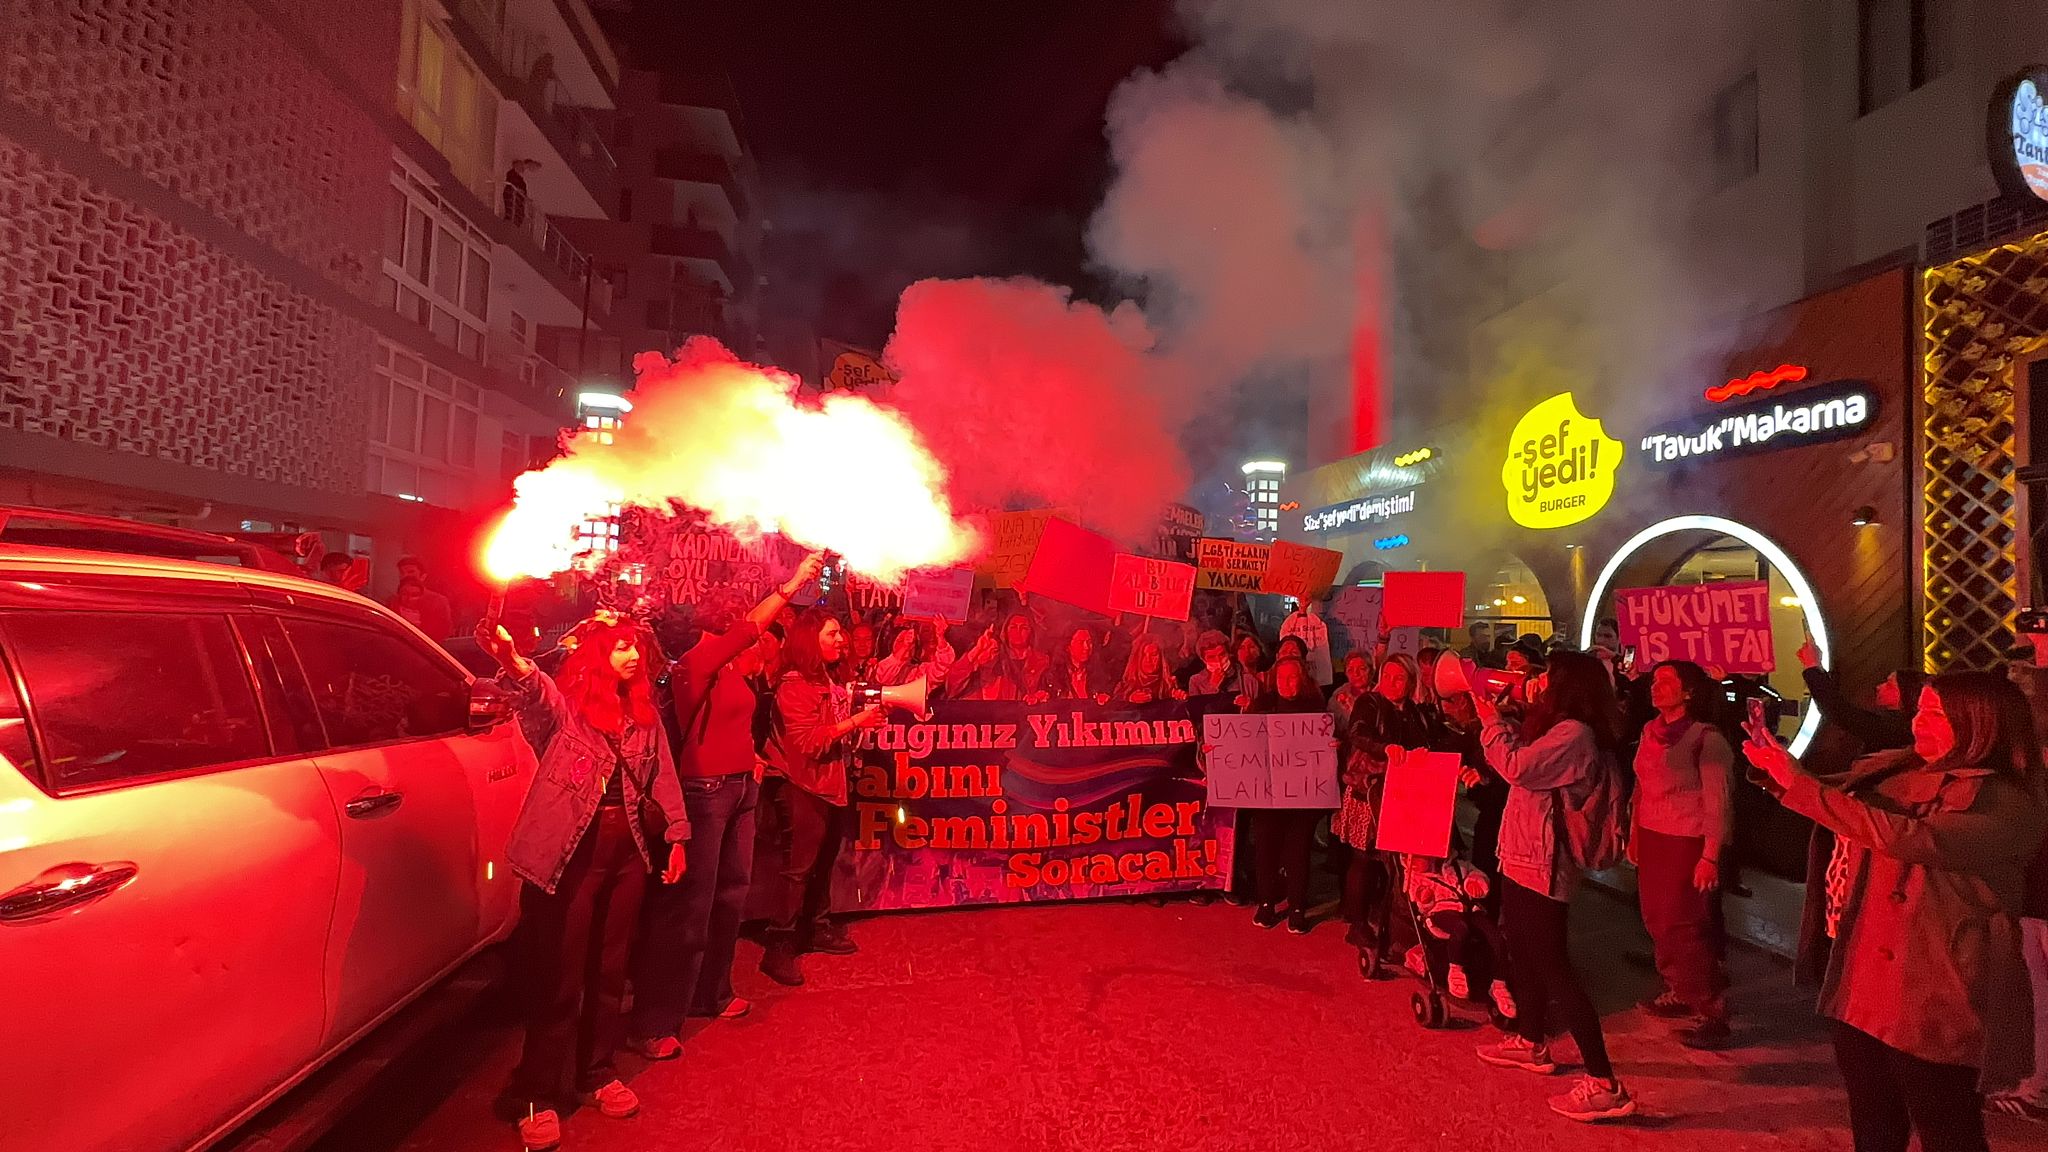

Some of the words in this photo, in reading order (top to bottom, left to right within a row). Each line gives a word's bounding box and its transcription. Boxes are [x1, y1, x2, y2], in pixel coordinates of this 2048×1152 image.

[1733, 395, 1867, 446] Makarna
[1522, 439, 1600, 503] yedi!
[1540, 494, 1586, 512] BURGER
[1207, 571, 1262, 591] YAKACAK
[1627, 585, 1768, 628] HÜKÜMET
[1026, 712, 1196, 748] Yıkımın
[855, 750, 1003, 799] abını
[855, 793, 1201, 851] Feministler
[1006, 838, 1218, 888] Soracak!
